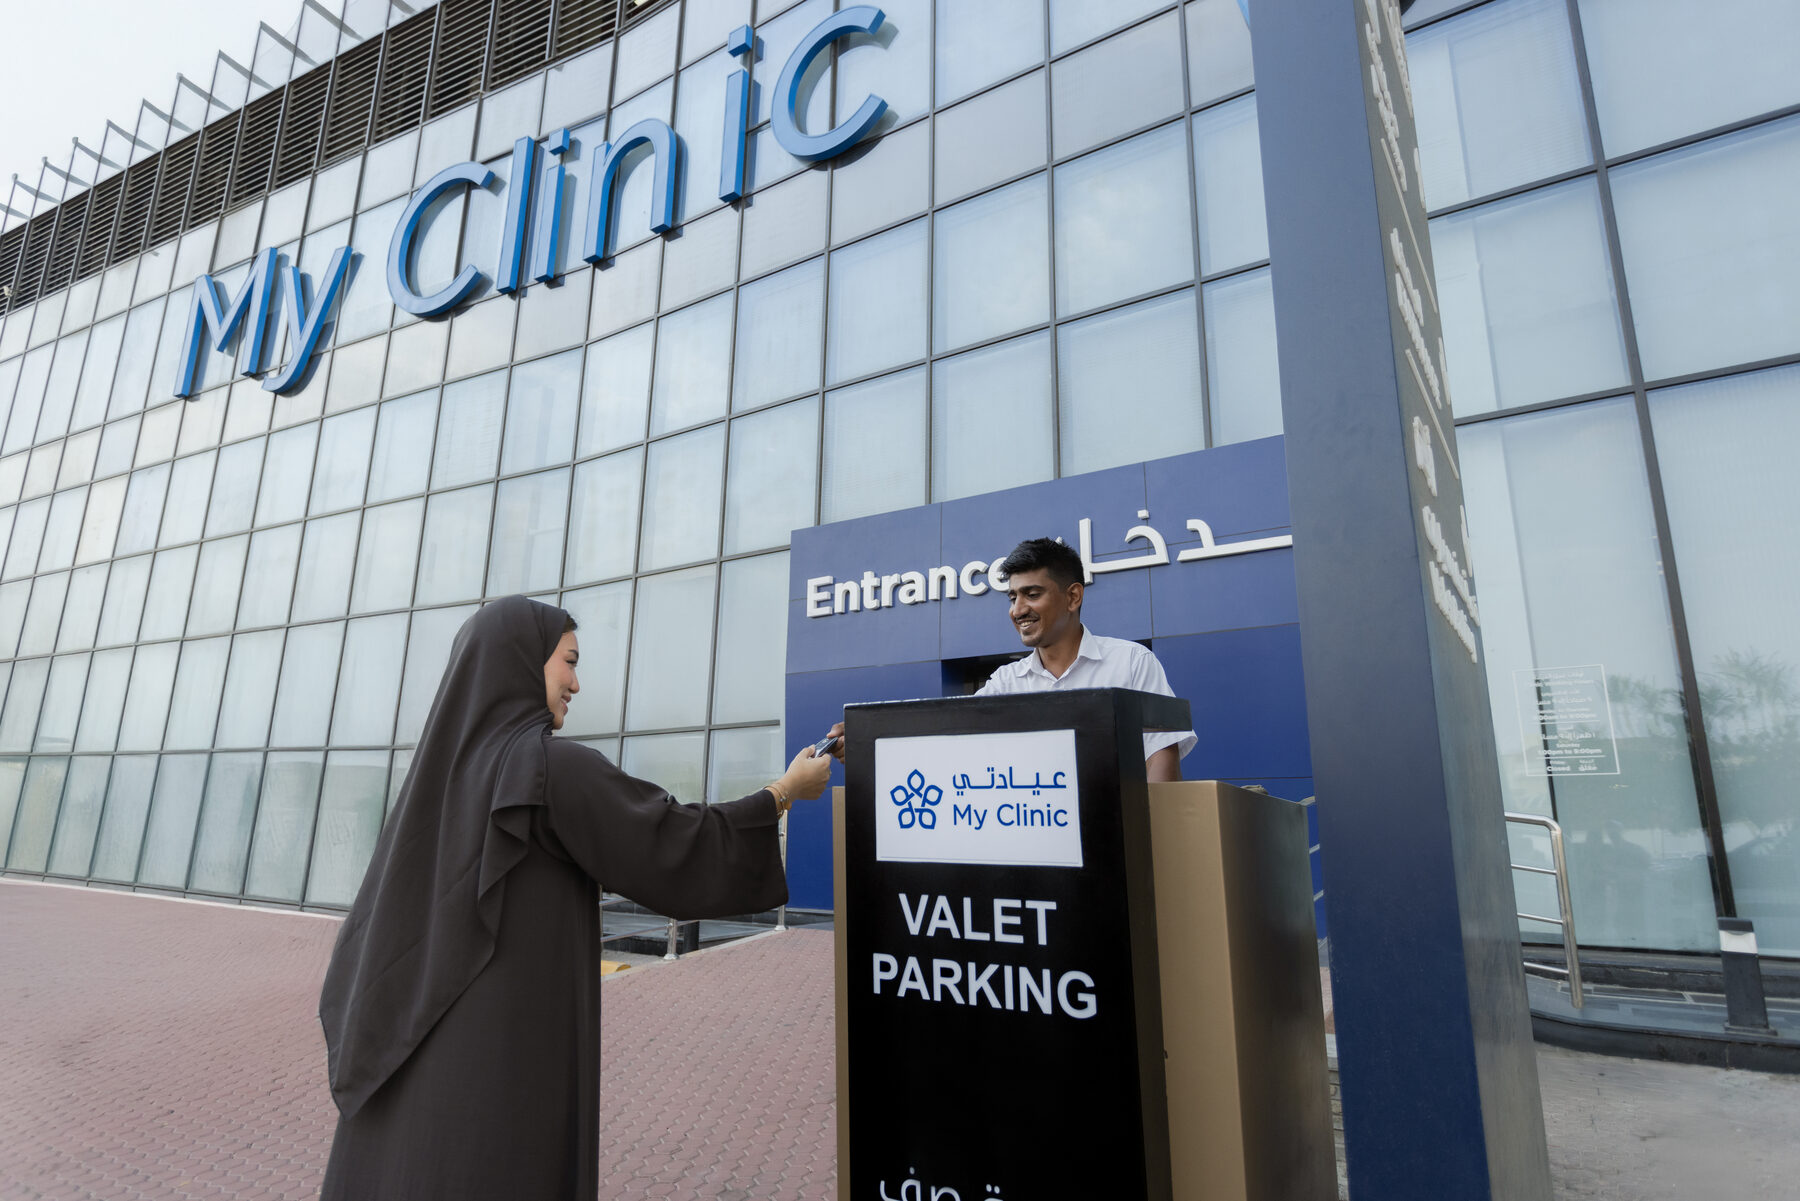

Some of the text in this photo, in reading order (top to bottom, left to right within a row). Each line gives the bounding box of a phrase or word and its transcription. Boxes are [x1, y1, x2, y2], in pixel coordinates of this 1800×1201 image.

[173, 5, 890, 398] My Clinic
[1054, 509, 1293, 585] دخل
[952, 766, 1067, 796] عيادتي
[953, 802, 1069, 830] My Clinic
[898, 893, 1057, 945] VALET
[873, 953, 1097, 1019] PARKING
